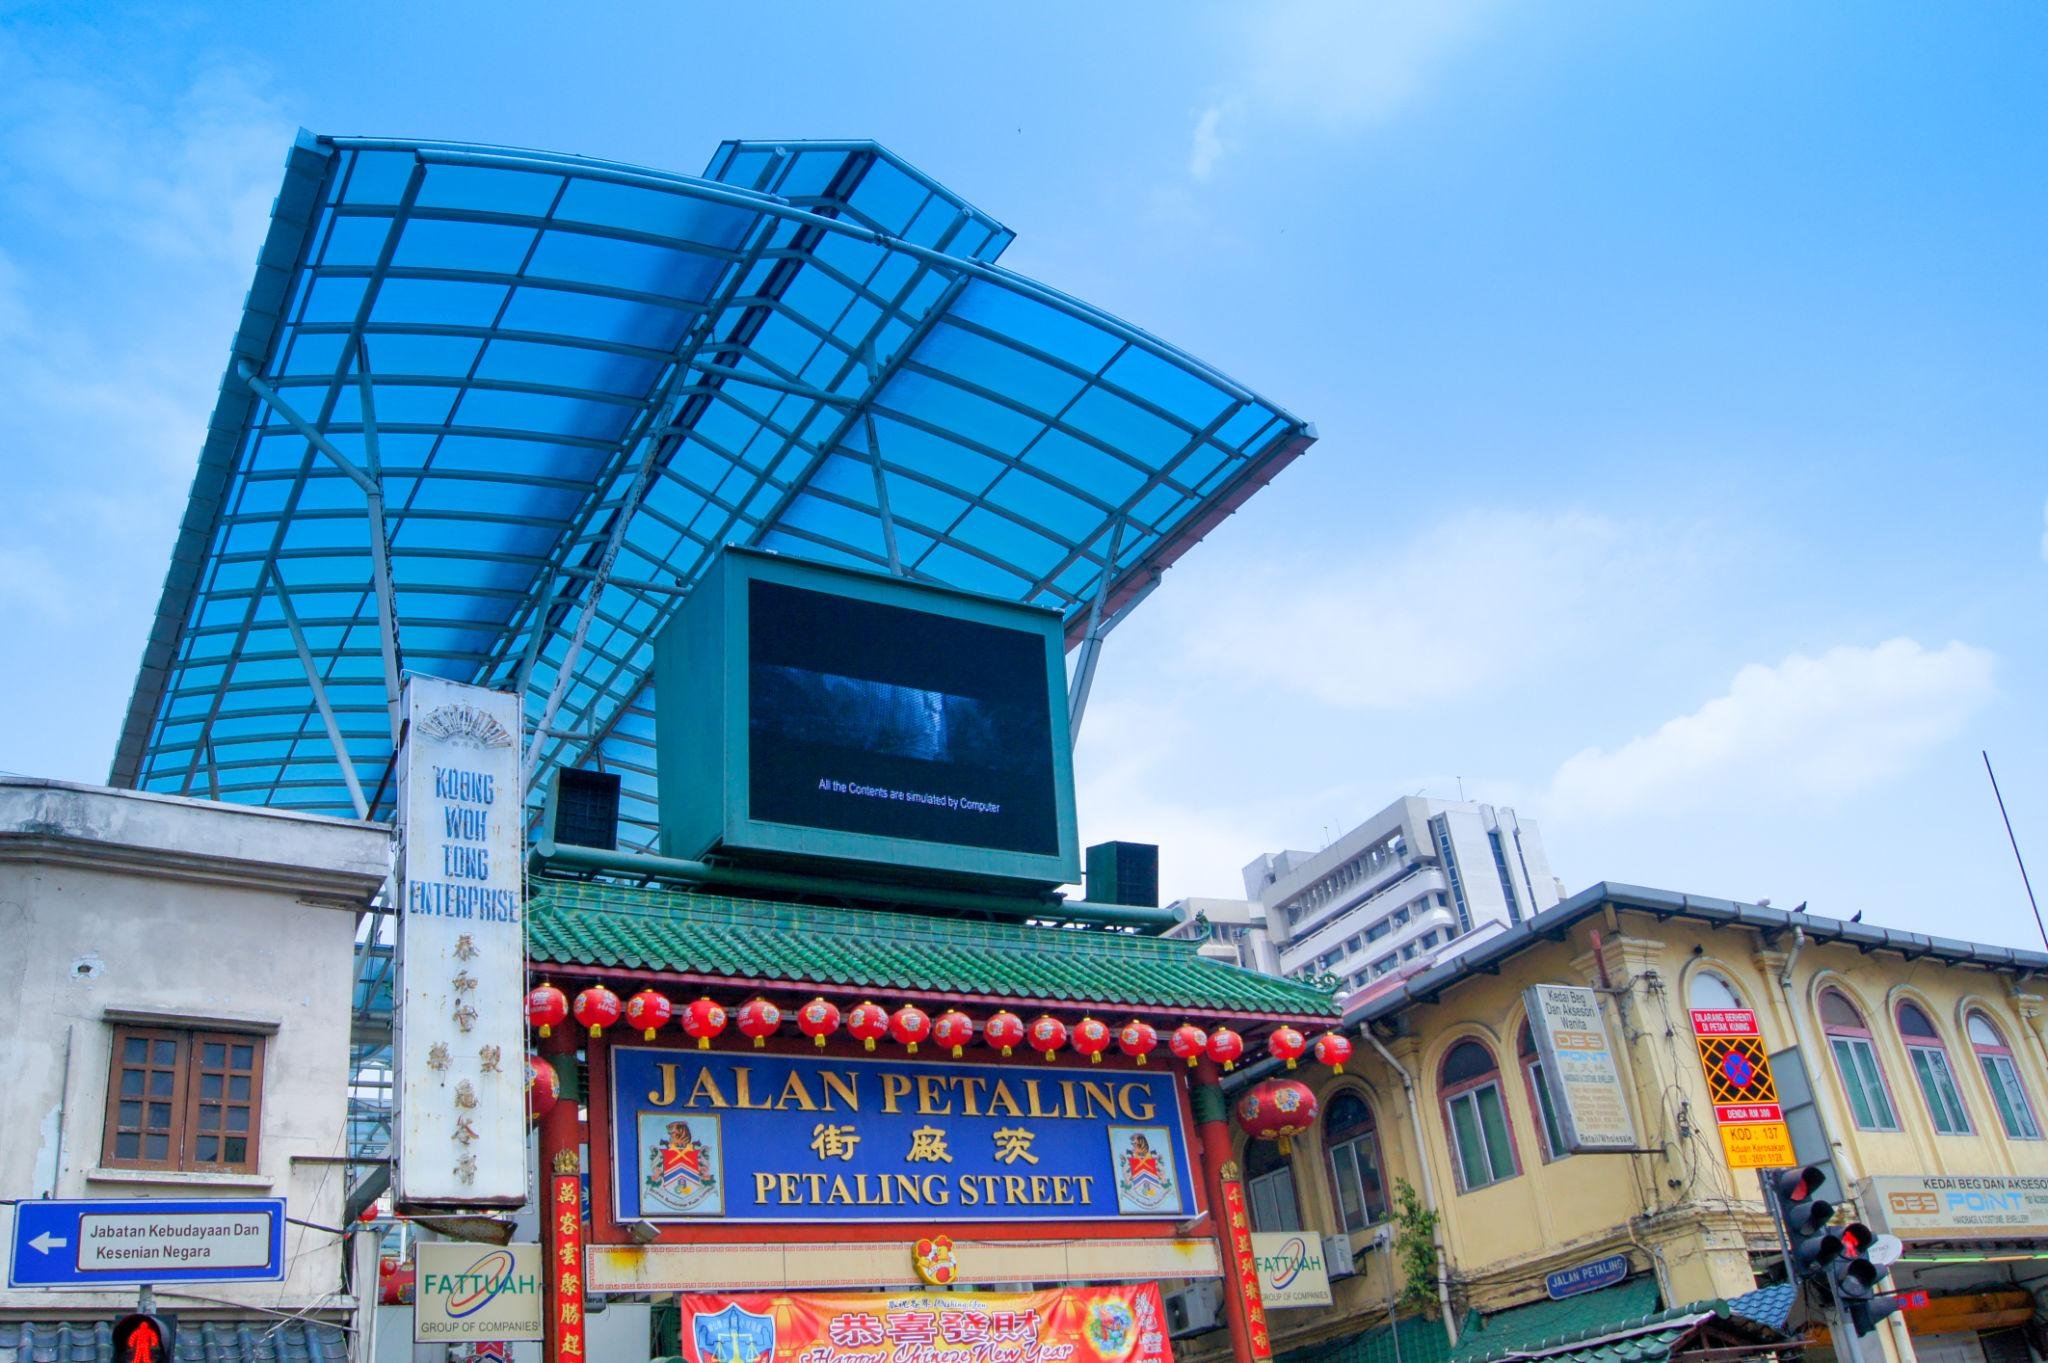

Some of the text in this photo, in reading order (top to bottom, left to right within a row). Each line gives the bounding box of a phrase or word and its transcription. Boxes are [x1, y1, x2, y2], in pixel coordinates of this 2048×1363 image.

[434, 766, 494, 804] KOONG
[818, 778, 1001, 813] All the Contents are simulated by Computer
[444, 805, 488, 842] WOH
[409, 879, 520, 924] ENTERPRISE
[1570, 991, 1586, 1007] Beg
[1695, 1012, 1725, 1023] DILARANG
[647, 1062, 1157, 1121] JALAN PETALING
[1727, 1108, 1748, 1119] DENDA
[753, 1172, 950, 1206] PETALING
[960, 1175, 1094, 1206] STREET
[1923, 1178, 2048, 1190] KEDAI BEG DAN AKSESO
[90, 1223, 259, 1240] Jabatan Kebudayaan Dan
[96, 1245, 211, 1261] Kesenian Negara
[1255, 1256, 1321, 1273] FATTUAH
[1552, 1273, 1580, 1288] JALAN
[1582, 1258, 1623, 1279] PETALING
[425, 1274, 534, 1295] FATTUAH
[421, 1321, 539, 1333] GROUP OF COMPANIES
[829, 1308, 1041, 1347] 恭喜發財
[892, 1342, 970, 1363] Chinese
[972, 1343, 1022, 1363] New
[1024, 1340, 1074, 1363] Year
